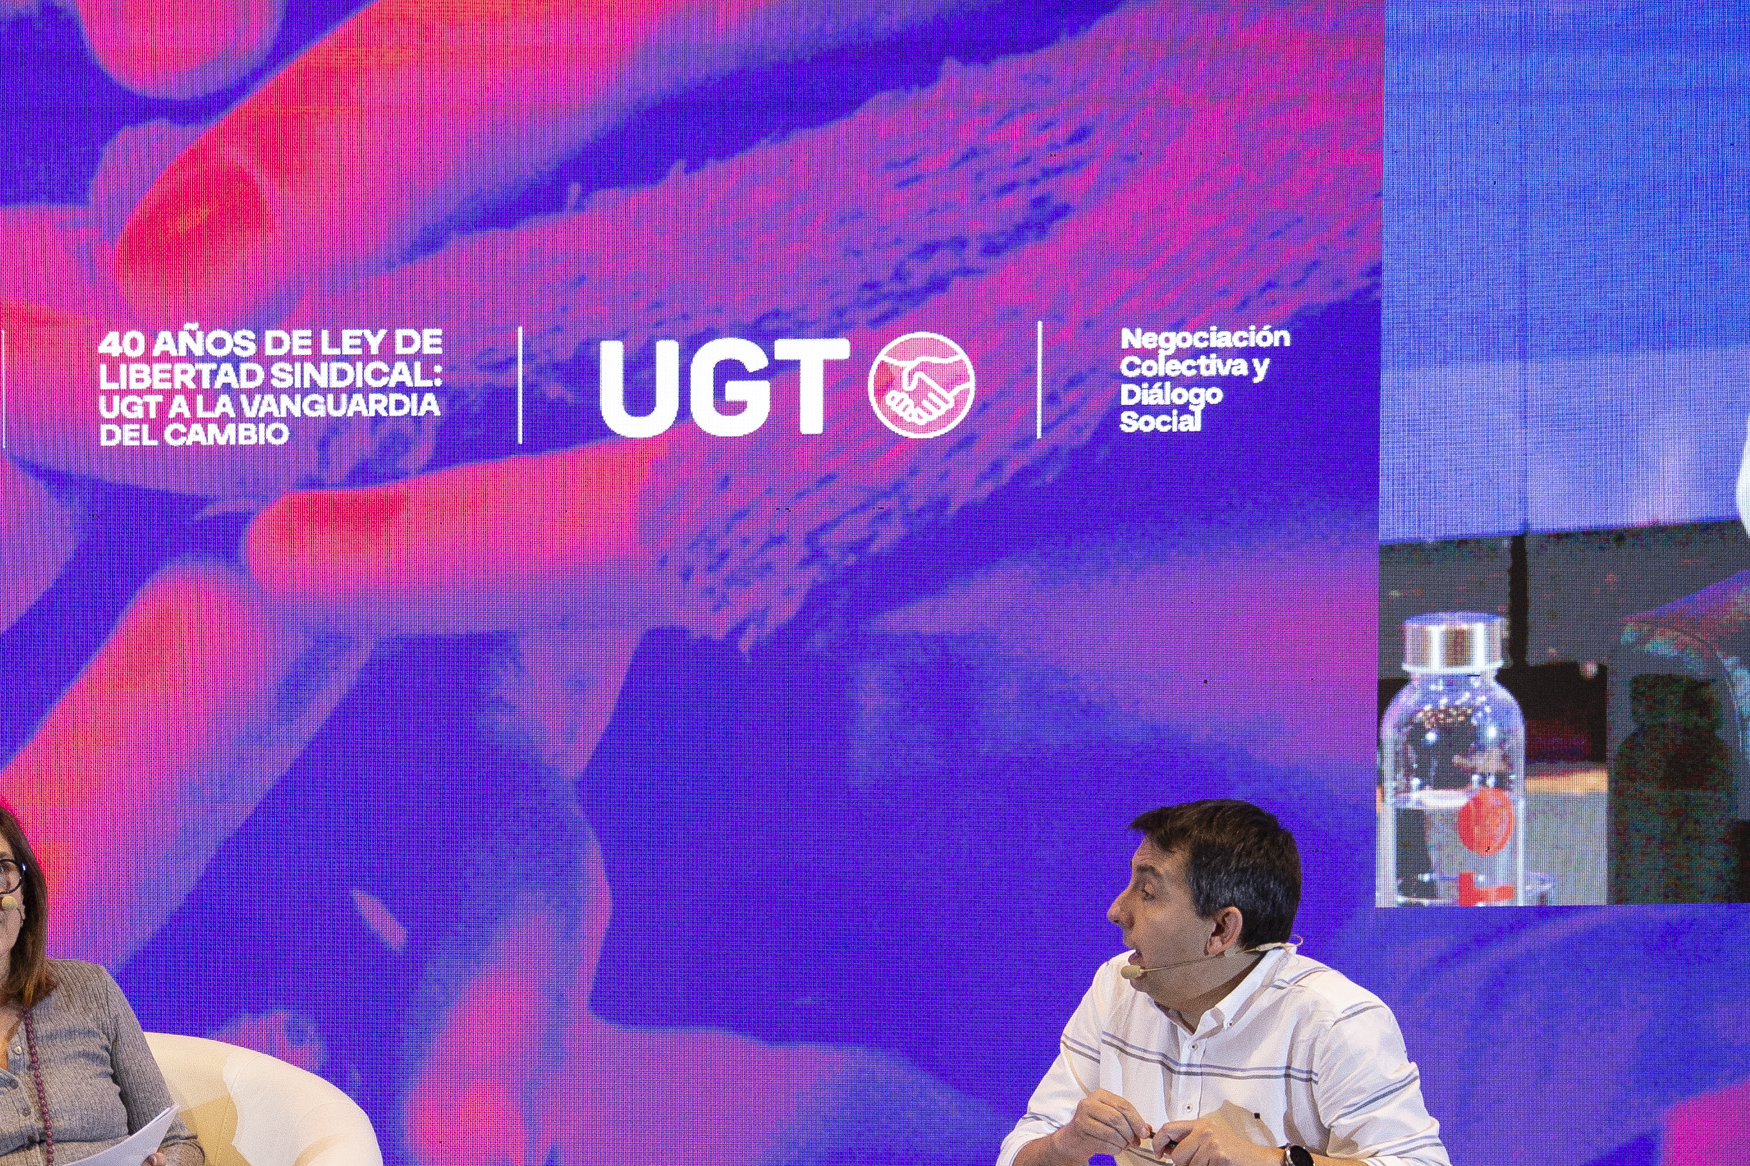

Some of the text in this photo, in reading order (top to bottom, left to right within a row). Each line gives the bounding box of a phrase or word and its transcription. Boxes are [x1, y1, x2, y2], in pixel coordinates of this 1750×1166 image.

[98, 323, 442, 358] 40 AÑOS DE LEY DE
[1121, 326, 1291, 355] Negociación
[100, 361, 442, 390] LIBERTAD SINDICAL:
[1120, 353, 1269, 383] Colectiva y
[600, 337, 850, 438] UGT
[1121, 381, 1223, 411] Diálogo
[100, 393, 441, 419] UGT A LA VANGUARDIA
[1119, 408, 1202, 433] Social
[101, 423, 289, 446] DEL CAMBIO
